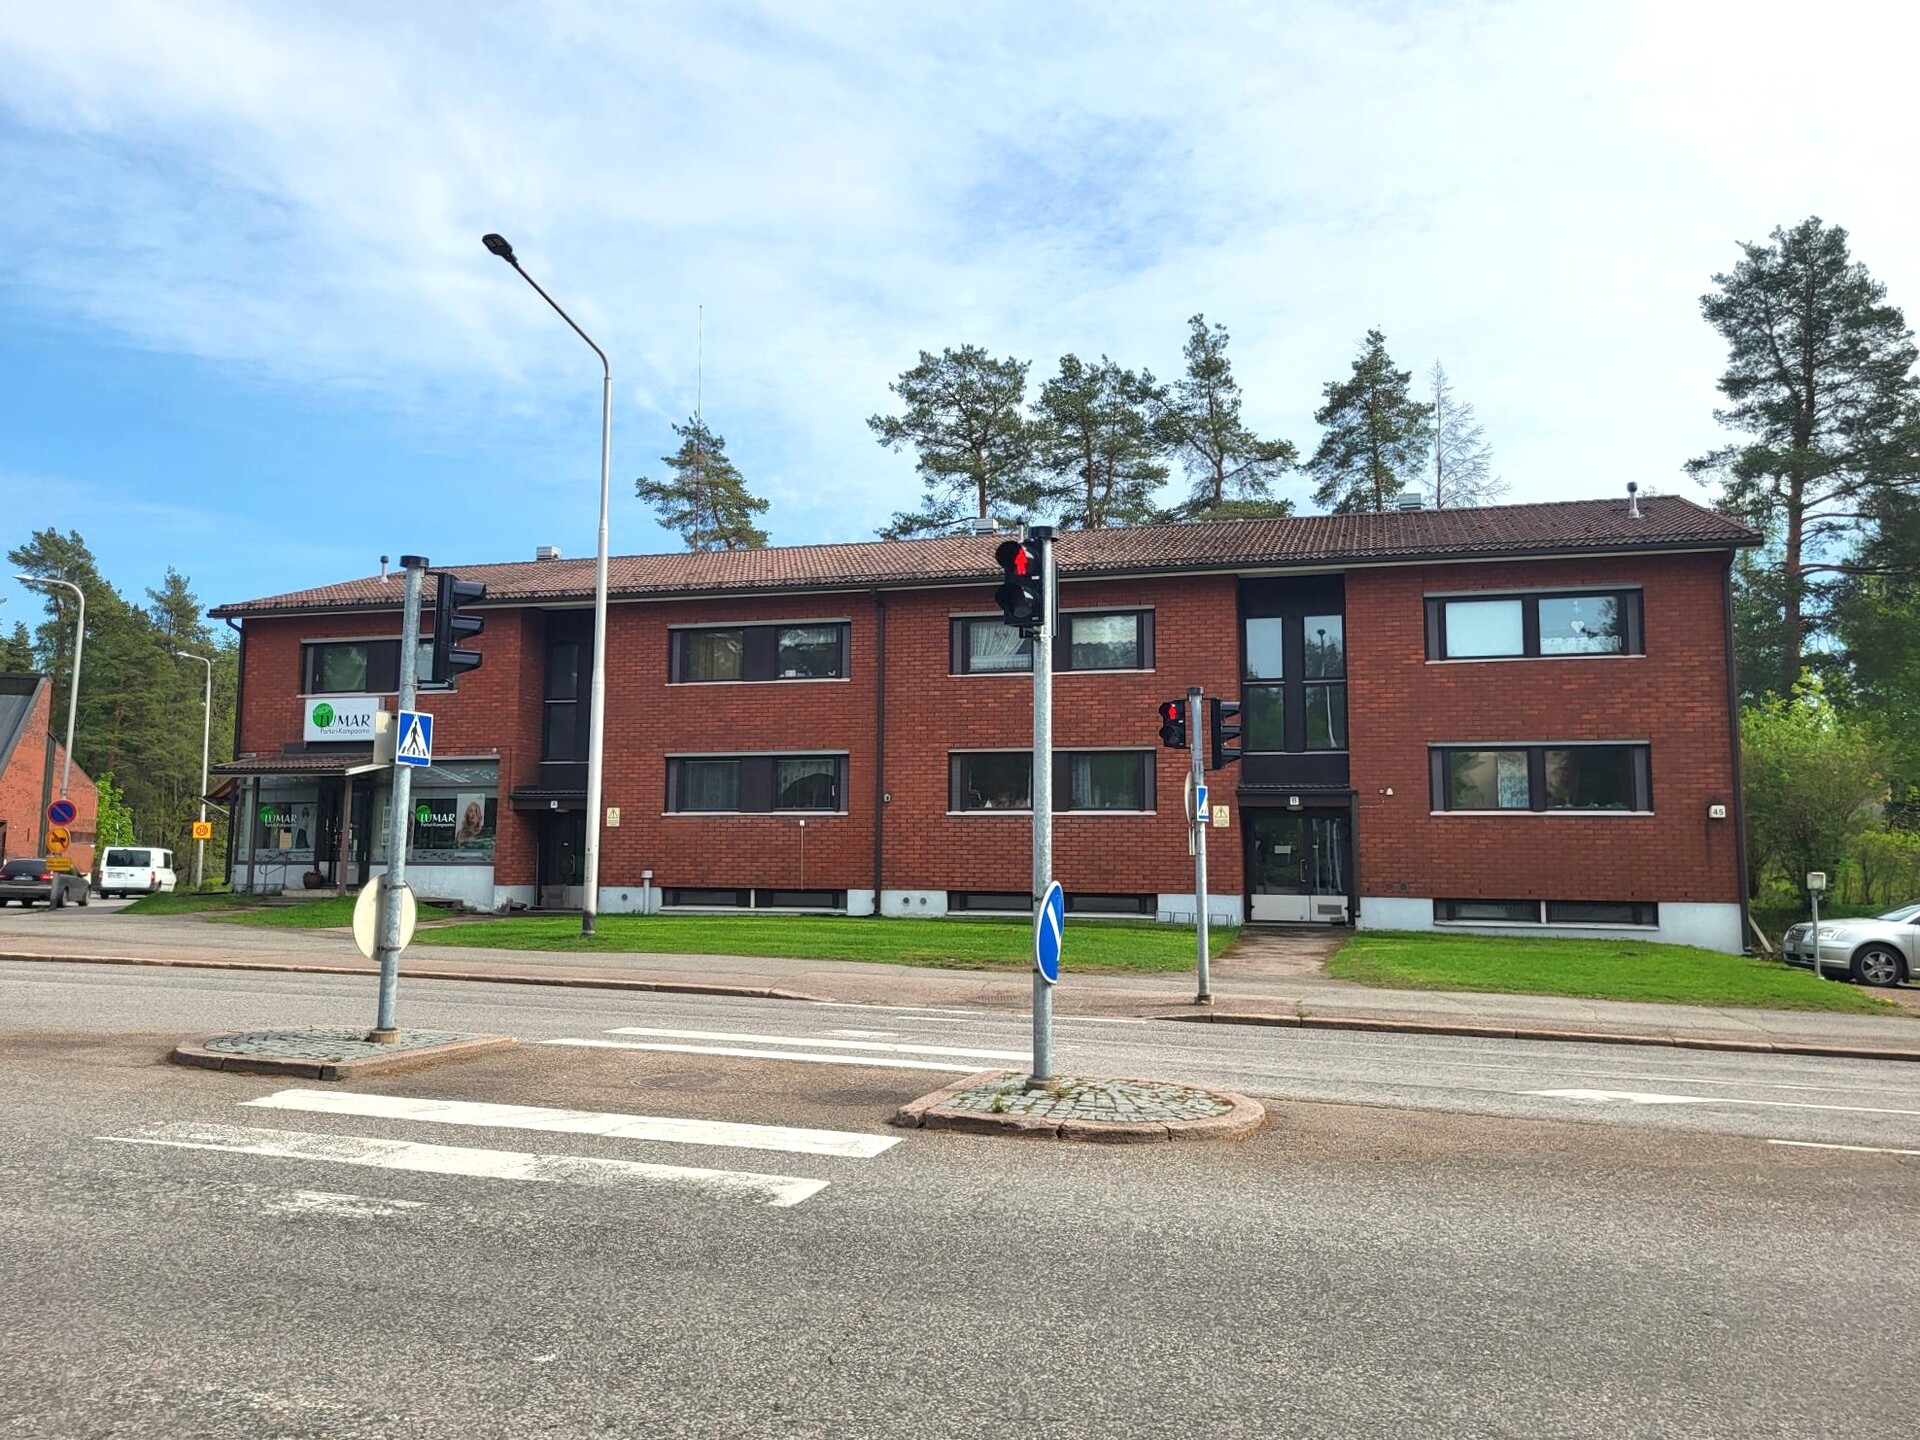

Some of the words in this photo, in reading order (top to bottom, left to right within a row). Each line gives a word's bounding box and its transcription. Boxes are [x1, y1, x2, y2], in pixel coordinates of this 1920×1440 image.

[320, 714, 371, 728] LUMAR
[264, 814, 298, 823] LUMAR
[420, 813, 456, 823] LUMAR
